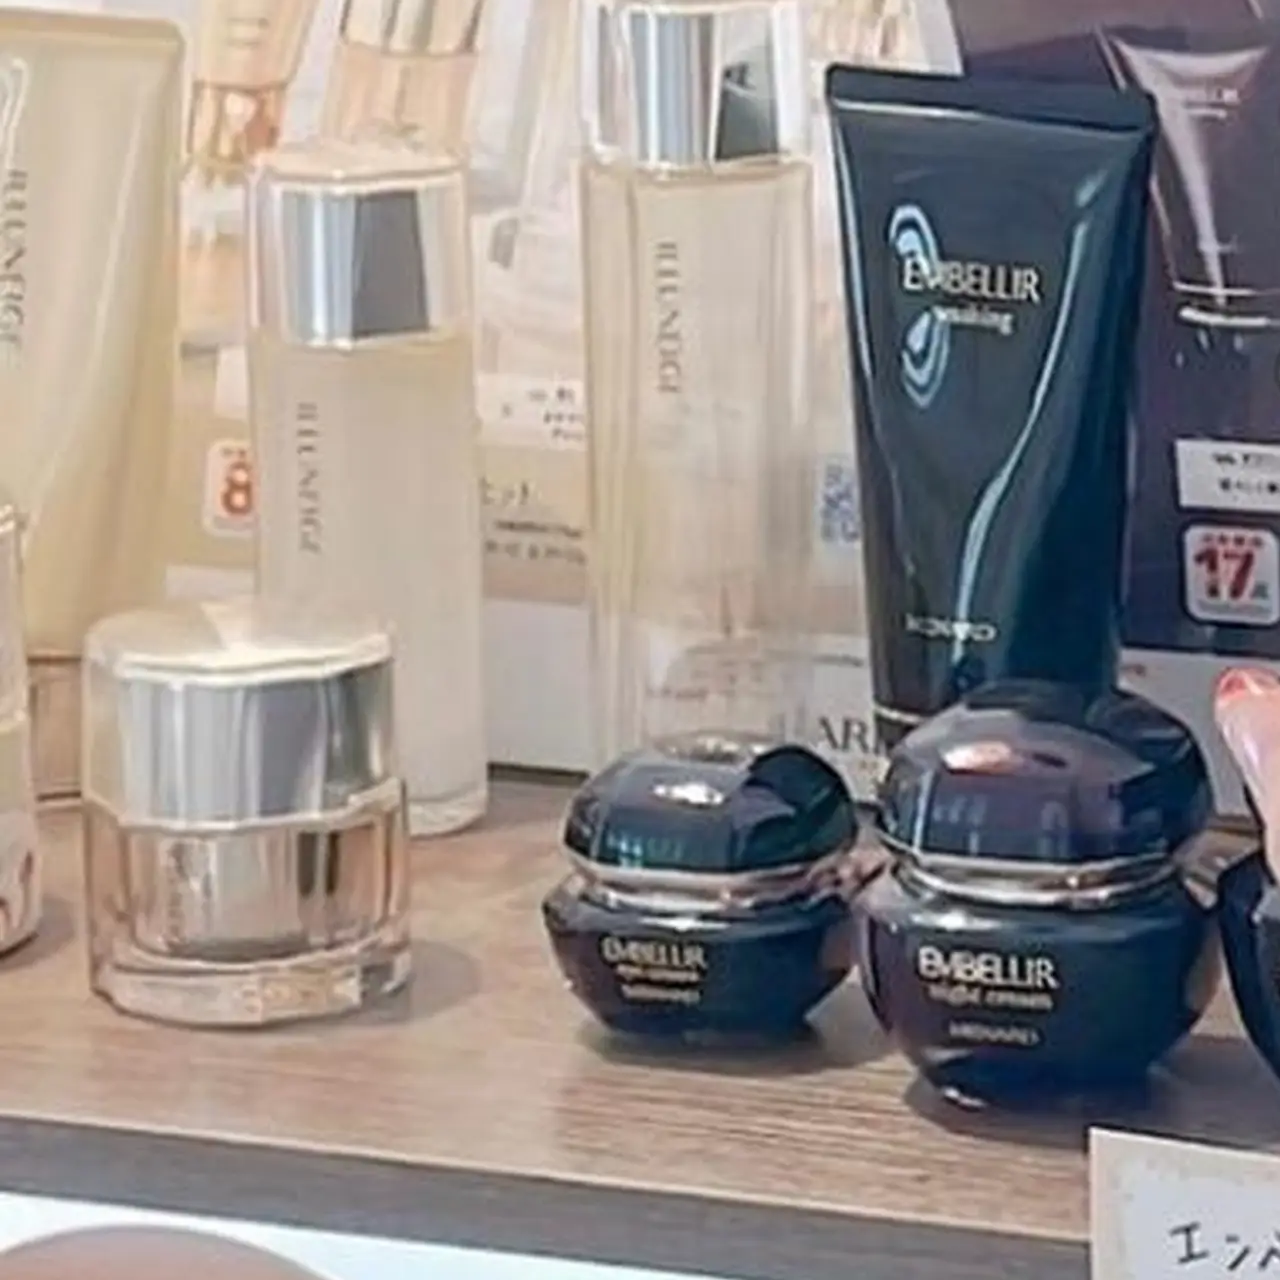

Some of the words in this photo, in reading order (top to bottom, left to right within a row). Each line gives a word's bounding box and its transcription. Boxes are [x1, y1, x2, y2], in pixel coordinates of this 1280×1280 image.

[903, 255, 1042, 305] EMBELLIR
[1194, 546, 1255, 602] 17
[918, 944, 1061, 990] EMBELLIR
